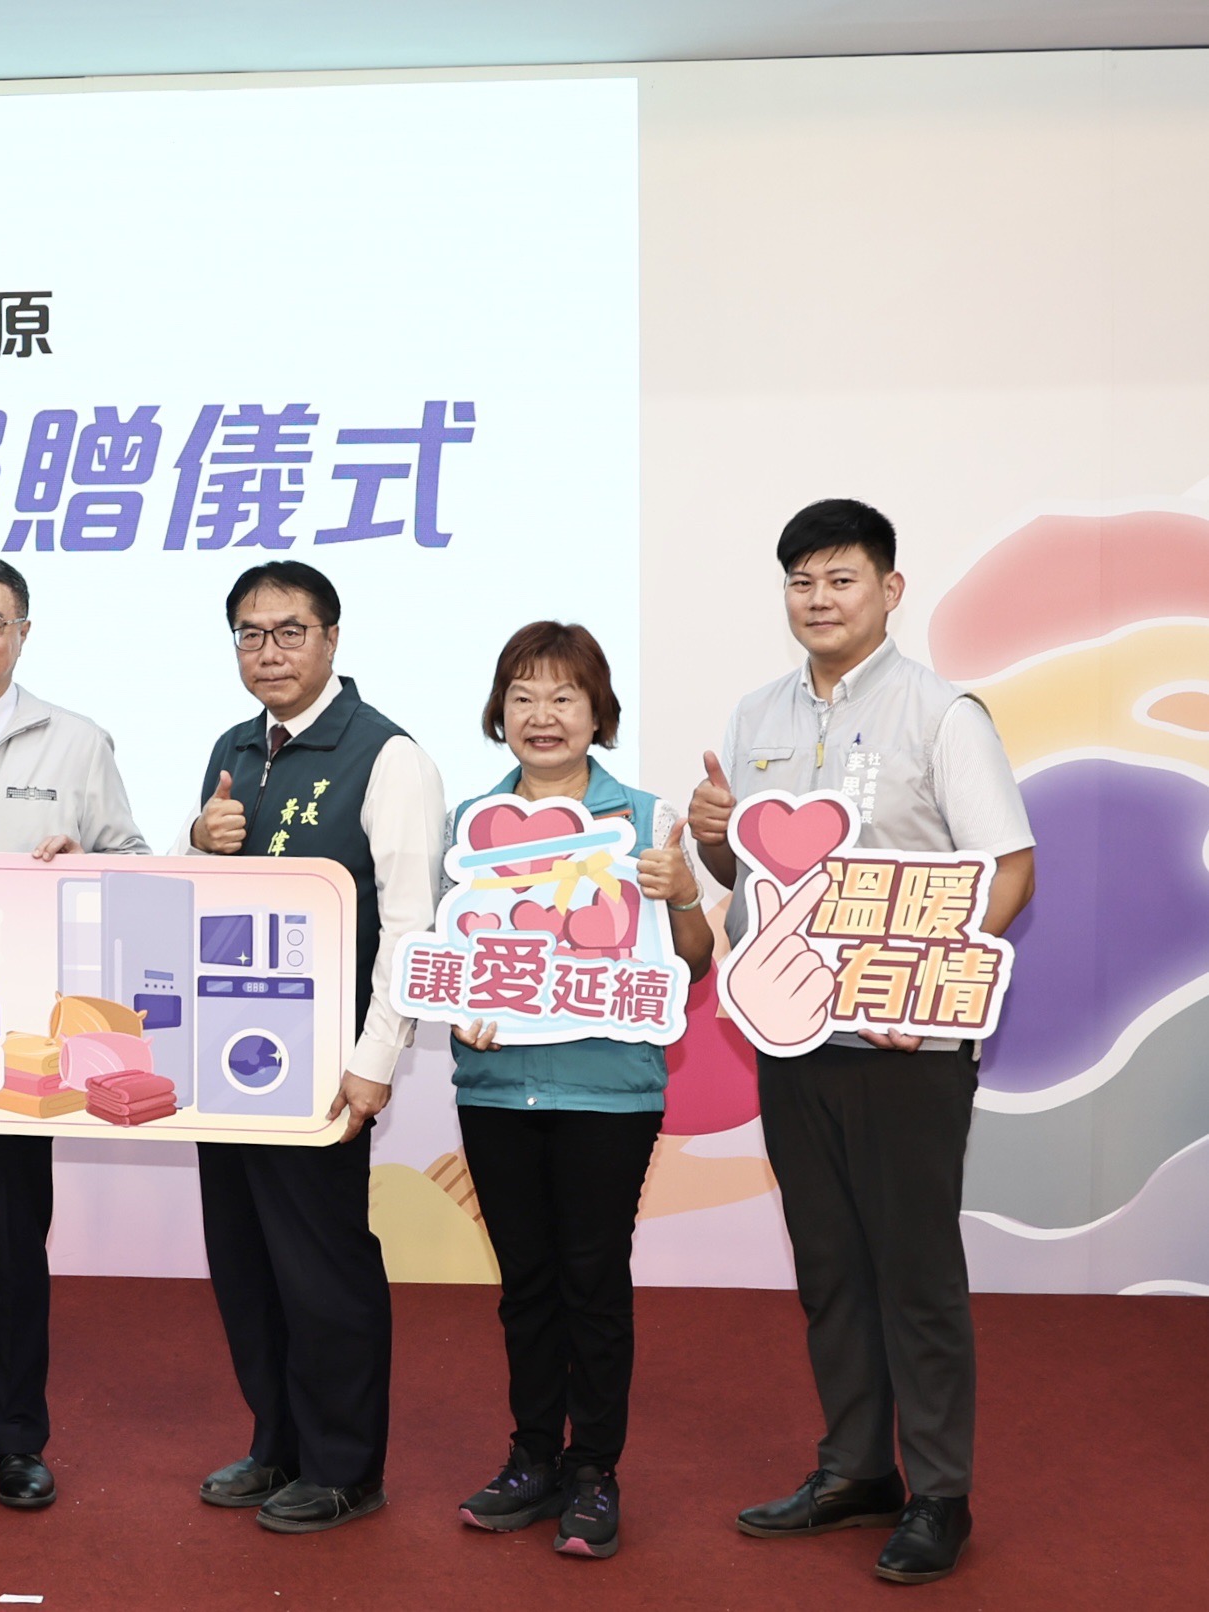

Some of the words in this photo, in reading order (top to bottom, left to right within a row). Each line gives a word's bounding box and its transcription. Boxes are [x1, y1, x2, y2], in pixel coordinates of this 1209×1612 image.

[300, 778, 330, 825] 市長
[809, 860, 981, 941] 溫暖
[408, 937, 670, 1026] 讓愛延續
[834, 942, 999, 1024] 有情
